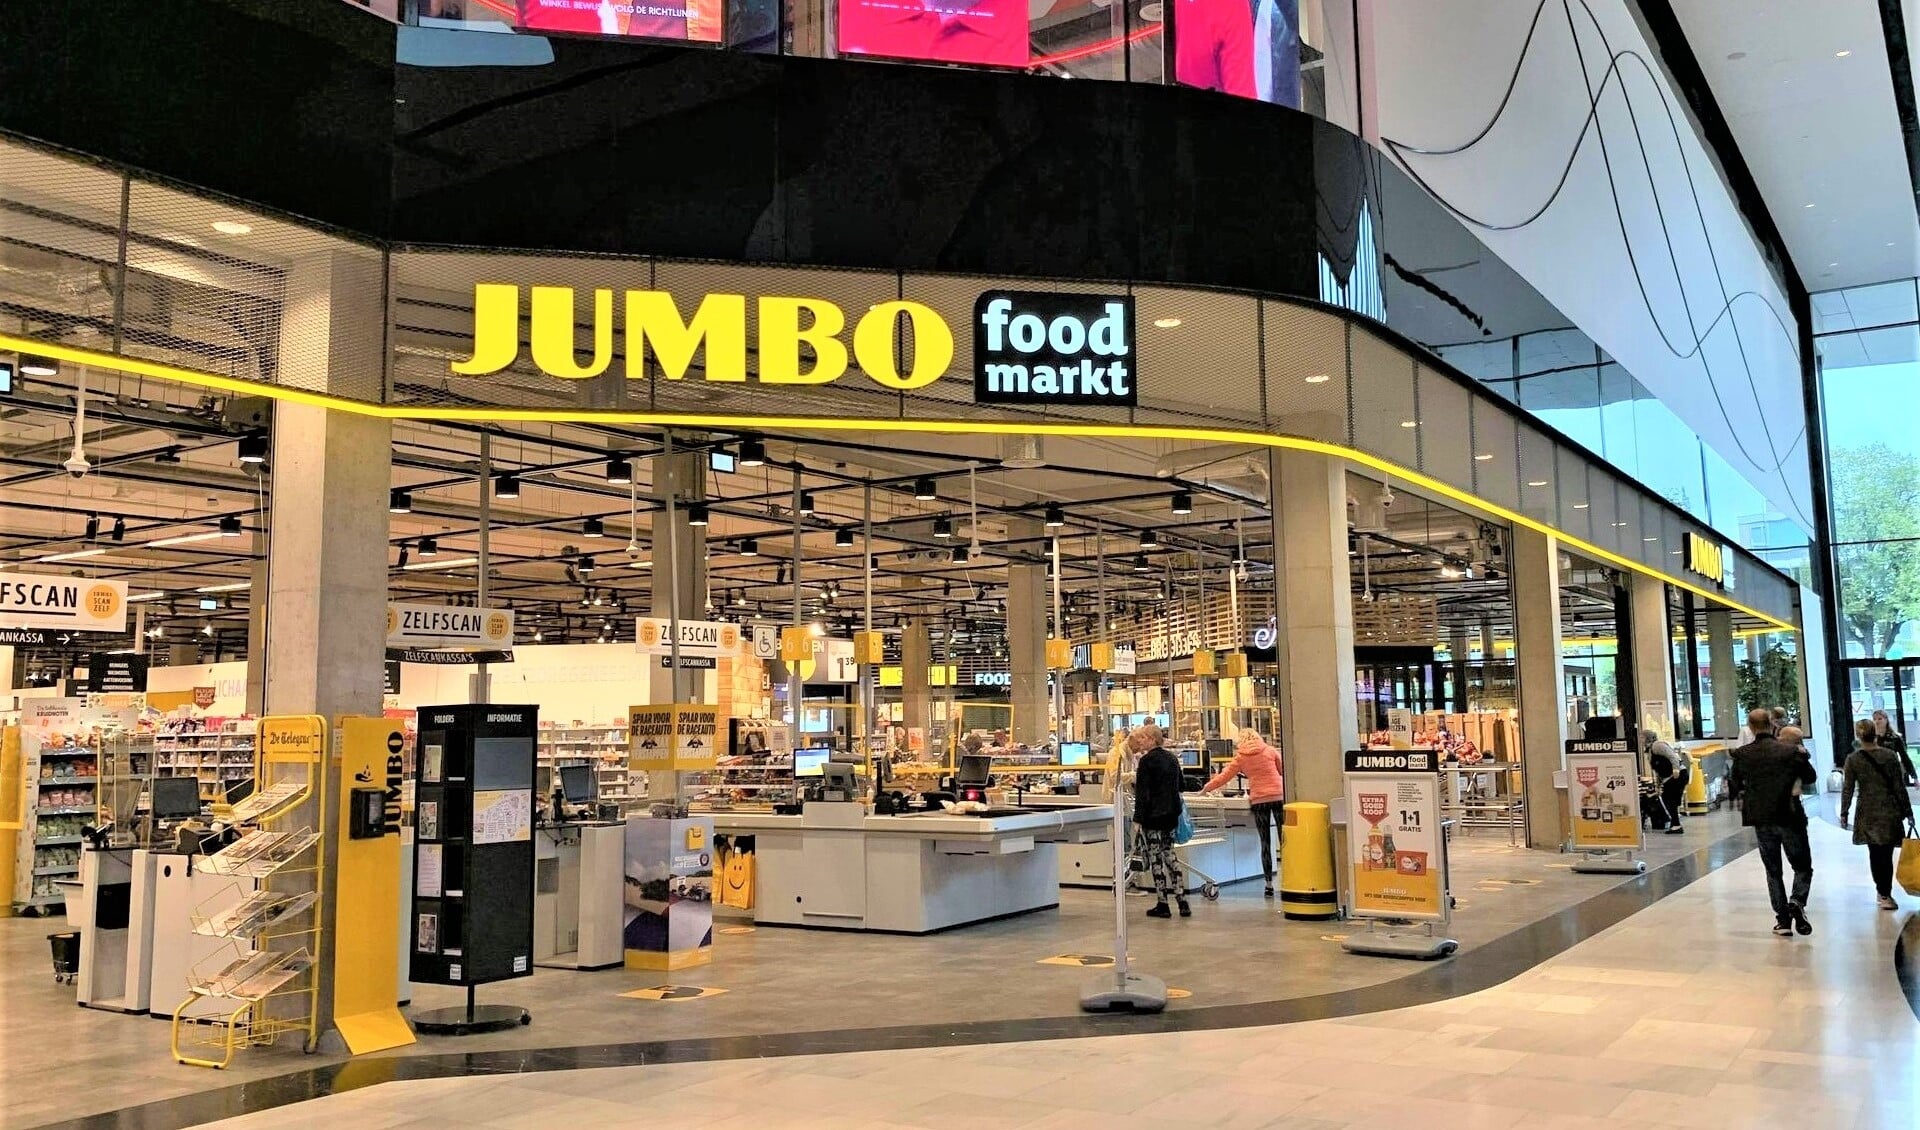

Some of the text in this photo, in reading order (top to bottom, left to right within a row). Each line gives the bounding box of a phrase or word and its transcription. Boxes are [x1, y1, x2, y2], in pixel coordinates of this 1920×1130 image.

[539, 0, 571, 9] WINKEL
[636, 6, 648, 15] DE
[649, 7, 699, 18] RICHTLIJNEN
[982, 299, 1129, 357] food
[451, 283, 954, 390] JUMBO
[985, 358, 1130, 397] markt
[1689, 532, 1722, 583] JUMBO
[403, 611, 481, 632] ZELFSCAN
[661, 625, 717, 642] ZFSCAN
[786, 636, 794, 653] 6
[802, 636, 810, 653] 6
[434, 714, 455, 724] FOLDERS
[487, 713, 522, 723] INFORMATIE
[632, 712, 671, 724] SPAAR VOOR
[678, 712, 716, 723] SPAAR VOOR
[631, 724, 672, 736] DE RACEAUTO
[677, 724, 716, 735] DE RACEAUTO
[270, 731, 280, 745] De
[1573, 742, 1612, 752] JUMBO
[1355, 756, 1407, 768] JUMBO
[1410, 755, 1426, 763] food
[384, 731, 404, 837] JUMBO
[1400, 810, 1420, 826] 1+1
